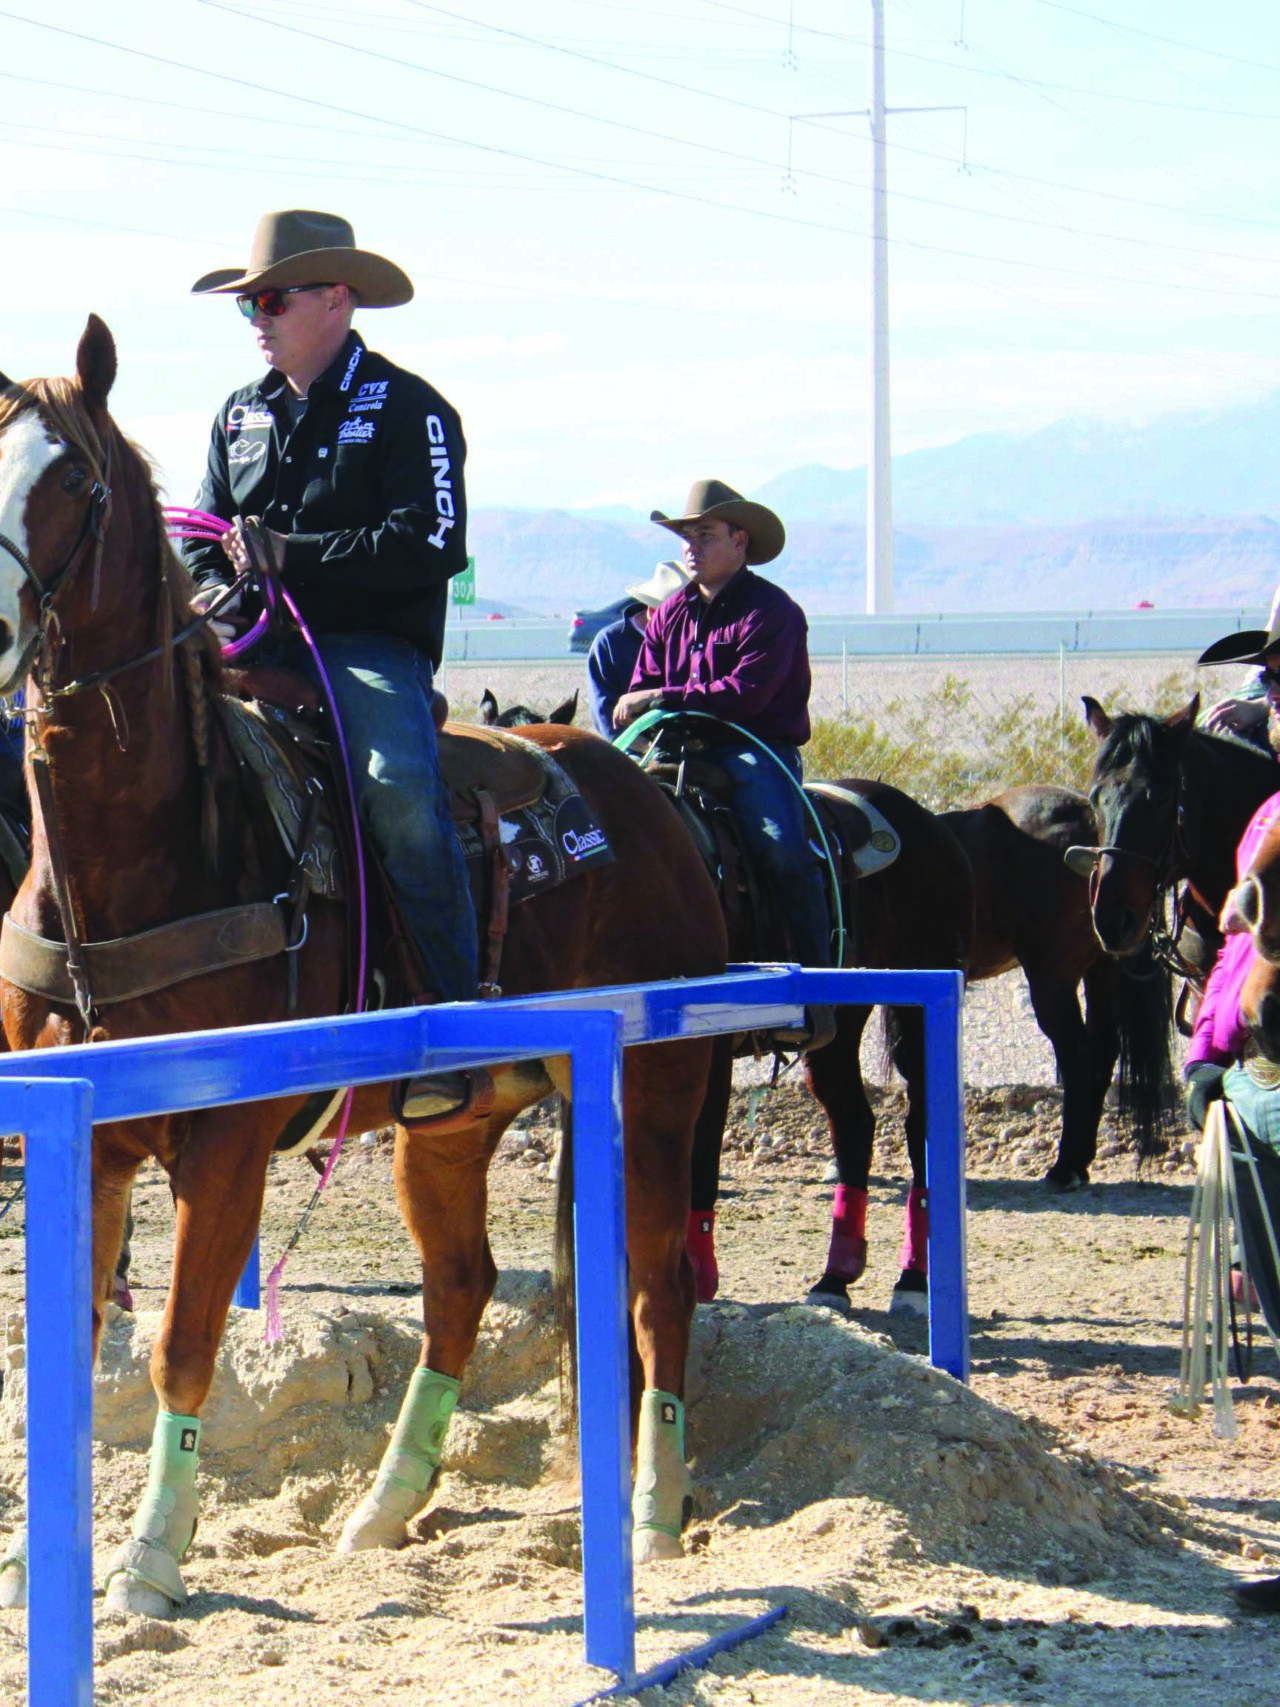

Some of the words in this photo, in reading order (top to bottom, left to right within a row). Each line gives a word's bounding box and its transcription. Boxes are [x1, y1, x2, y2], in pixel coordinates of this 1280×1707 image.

[339, 345, 363, 392] CINCH
[358, 380, 390, 397] CVS
[348, 400, 384, 412] Controls
[426, 414, 456, 550] CINCH
[562, 825, 606, 855] Classic
